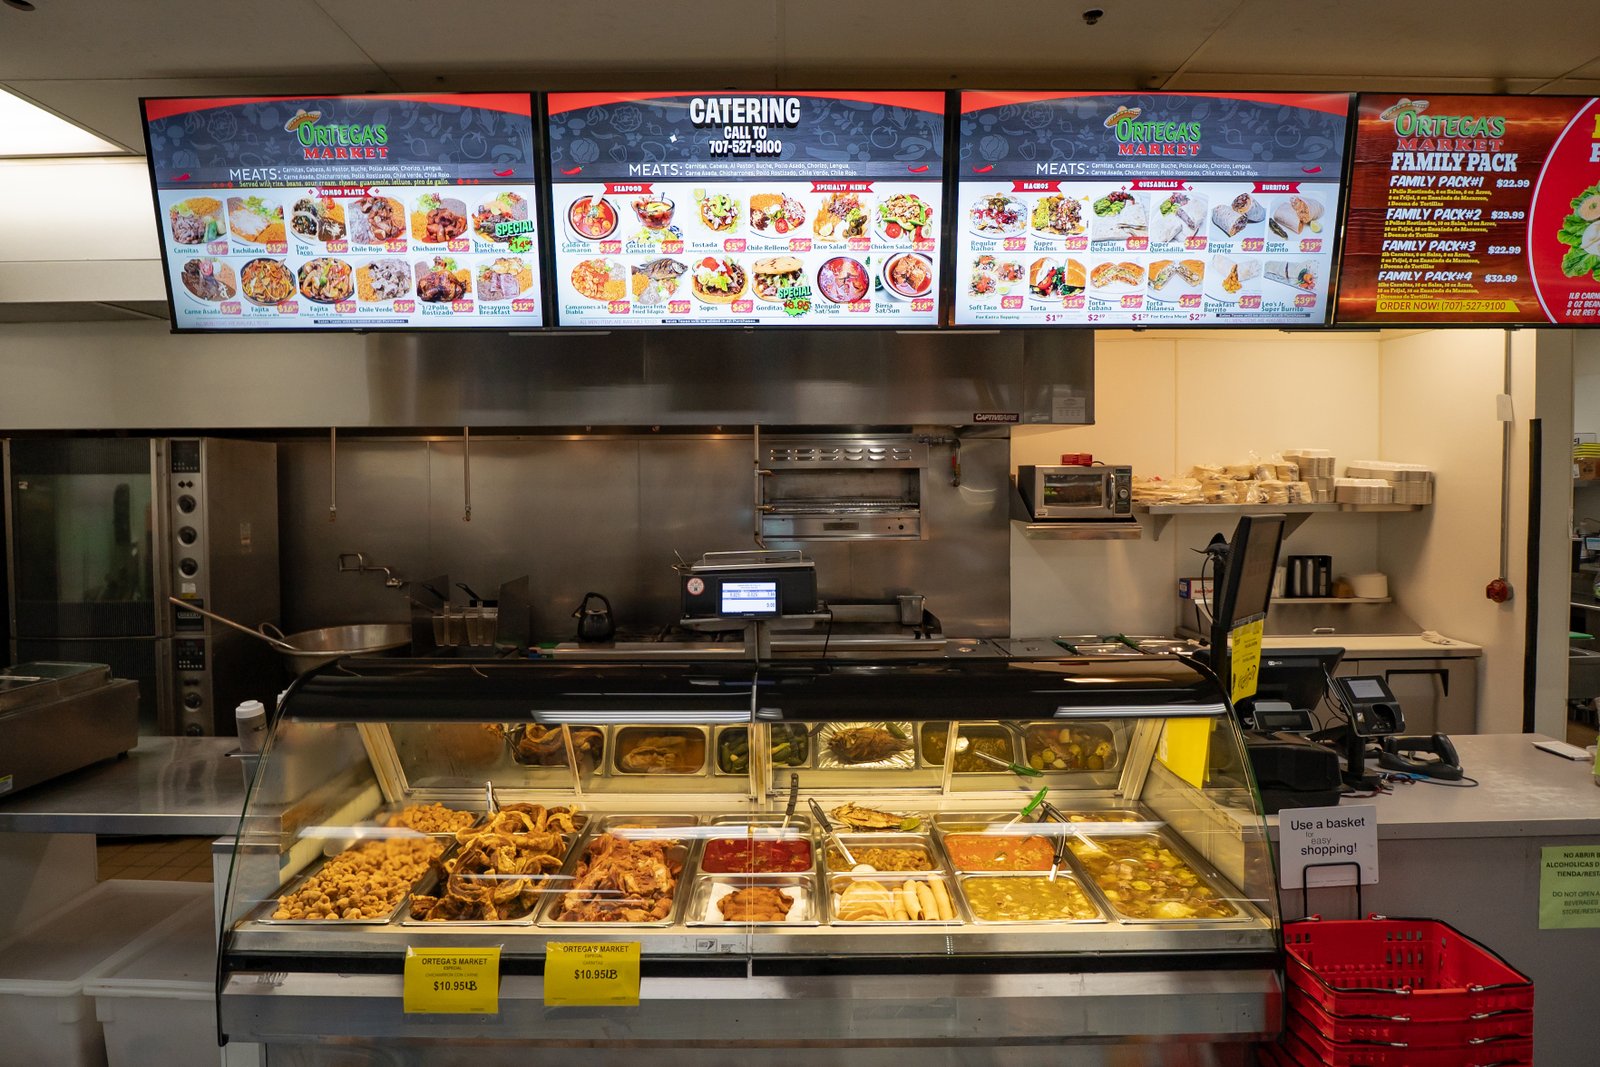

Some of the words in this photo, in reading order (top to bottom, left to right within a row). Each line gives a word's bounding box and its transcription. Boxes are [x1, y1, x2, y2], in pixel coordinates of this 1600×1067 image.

[690, 97, 801, 125] CATERING
[1396, 110, 1507, 138] ORTEGA'S
[724, 126, 751, 139] CALL
[752, 126, 767, 139] TO
[709, 140, 782, 154] 707-527-9100
[1117, 143, 1200, 155] MARKET
[1397, 137, 1505, 152] MARKET
[303, 146, 389, 160] MARKET
[1391, 152, 1467, 172] FAMILY
[1467, 153, 1519, 172] PACK
[229, 168, 281, 181] MEATS:
[629, 163, 683, 176] MEATS:
[1036, 163, 1090, 175] MEATS:
[1390, 176, 1435, 188] FAMILY
[1438, 176, 1484, 188] PACK#1
[1496, 179, 1530, 188] $22.99
[1386, 208, 1432, 220] FAMILY
[1433, 208, 1482, 220] PACK#2
[1491, 211, 1525, 220] $29.99
[495, 221, 534, 237] SPECIAL
[1382, 240, 1427, 252] FAMILY
[1428, 240, 1476, 252] PACK#3
[1488, 245, 1522, 255] $22.99
[1378, 271, 1422, 281] FAMILY
[1424, 272, 1473, 281] PACK#4
[1485, 274, 1518, 283] $32.99
[778, 286, 812, 299] SPECIAL
[250, 306, 270, 314] Fajita
[310, 305, 329, 313] Fajita
[1380, 301, 1413, 311] ORDER
[1414, 301, 1440, 311] NOW!
[1441, 301, 1505, 312] (707)-527-9100
[1290, 820, 1313, 831] Use
[1316, 821, 1323, 829] a
[1326, 817, 1365, 829] basket
[1311, 838, 1332, 846] easy
[1300, 843, 1357, 856] shopping!
[563, 945, 599, 953] ORTEGA'S
[600, 945, 629, 953] MARKET
